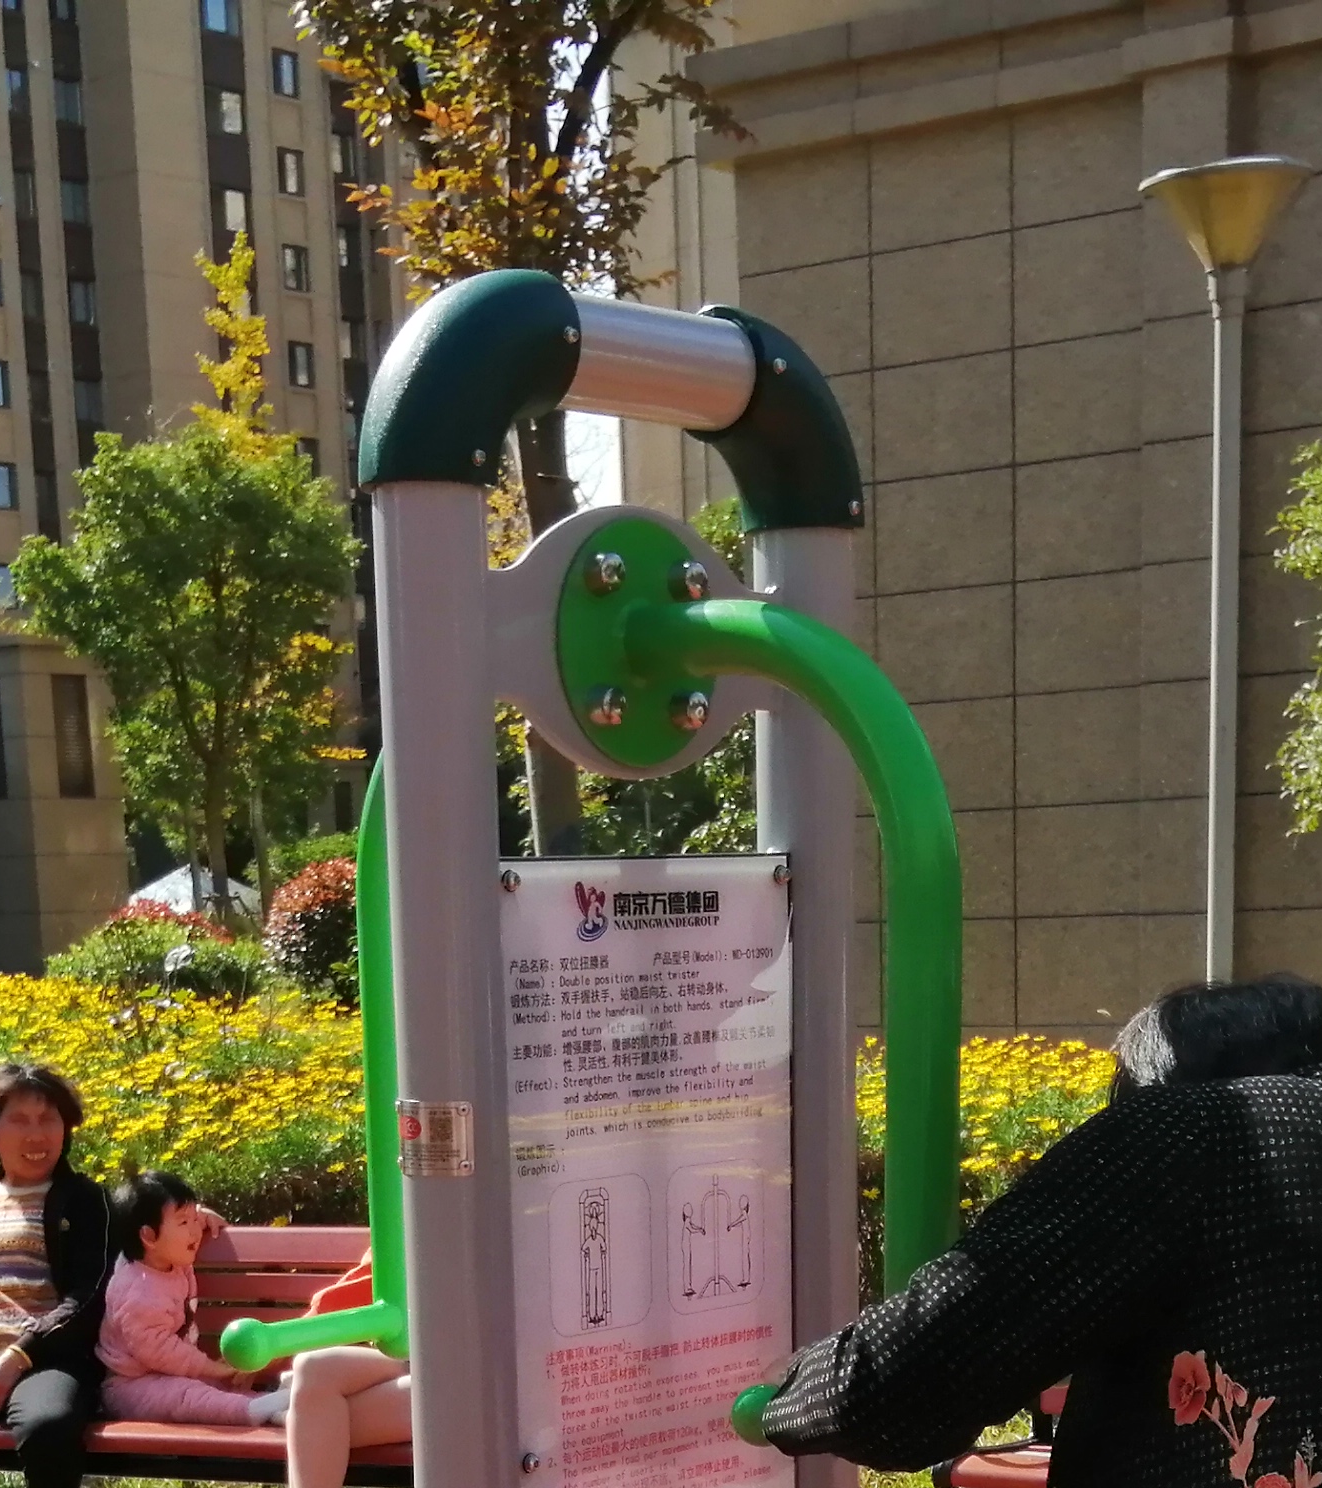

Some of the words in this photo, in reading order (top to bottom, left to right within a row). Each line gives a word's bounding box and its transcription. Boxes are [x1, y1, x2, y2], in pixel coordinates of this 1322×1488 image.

[612, 889, 719, 916] 南京万德集团
[613, 915, 720, 930] NANJINGWANDEGROUP
[559, 974, 590, 987] Double
[594, 973, 634, 986] position
[667, 969, 700, 980] twister
[560, 1008, 581, 1021] Hold
[586, 1007, 601, 1019] the
[604, 1004, 644, 1018] handrail
[650, 1004, 659, 1014] in
[662, 1001, 682, 1013] both
[719, 996, 743, 1009] stand
[561, 1026, 577, 1038] and
[581, 1025, 602, 1036] turn
[562, 1073, 613, 1088] Strengthen
[616, 1071, 631, 1083] the
[635, 1068, 664, 1081] muscle
[669, 1063, 707, 1077] strength
[710, 1062, 720, 1073] of
[725, 1060, 740, 1072] the
[563, 1092, 579, 1105] and
[627, 1086, 660, 1098] improve
[665, 1082, 680, 1094] the
[684, 1077, 735, 1091] flexibility
[738, 1074, 753, 1086] and
[564, 1106, 618, 1121] flexibility
[622, 1102, 631, 1115] of
[637, 1103, 651, 1113] the
[716, 1092, 730, 1104] and
[603, 1121, 628, 1133] which
[634, 1120, 642, 1130] is
[694, 1112, 703, 1123] to
[584, 1388, 609, 1402] doing
[613, 1379, 652, 1394] rotation
[706, 1366, 720, 1376] you
[746, 1356, 760, 1367] not
[614, 1398, 628, 1409] the
[632, 1391, 661, 1404] handle
[665, 1389, 675, 1399] to
[715, 1377, 729, 1388] the
[590, 1417, 600, 1429] of
[604, 1415, 619, 1426] the
[562, 1438, 576, 1450] the
[704, 1436, 712, 1446] is
[615, 1469, 625, 1481] of
